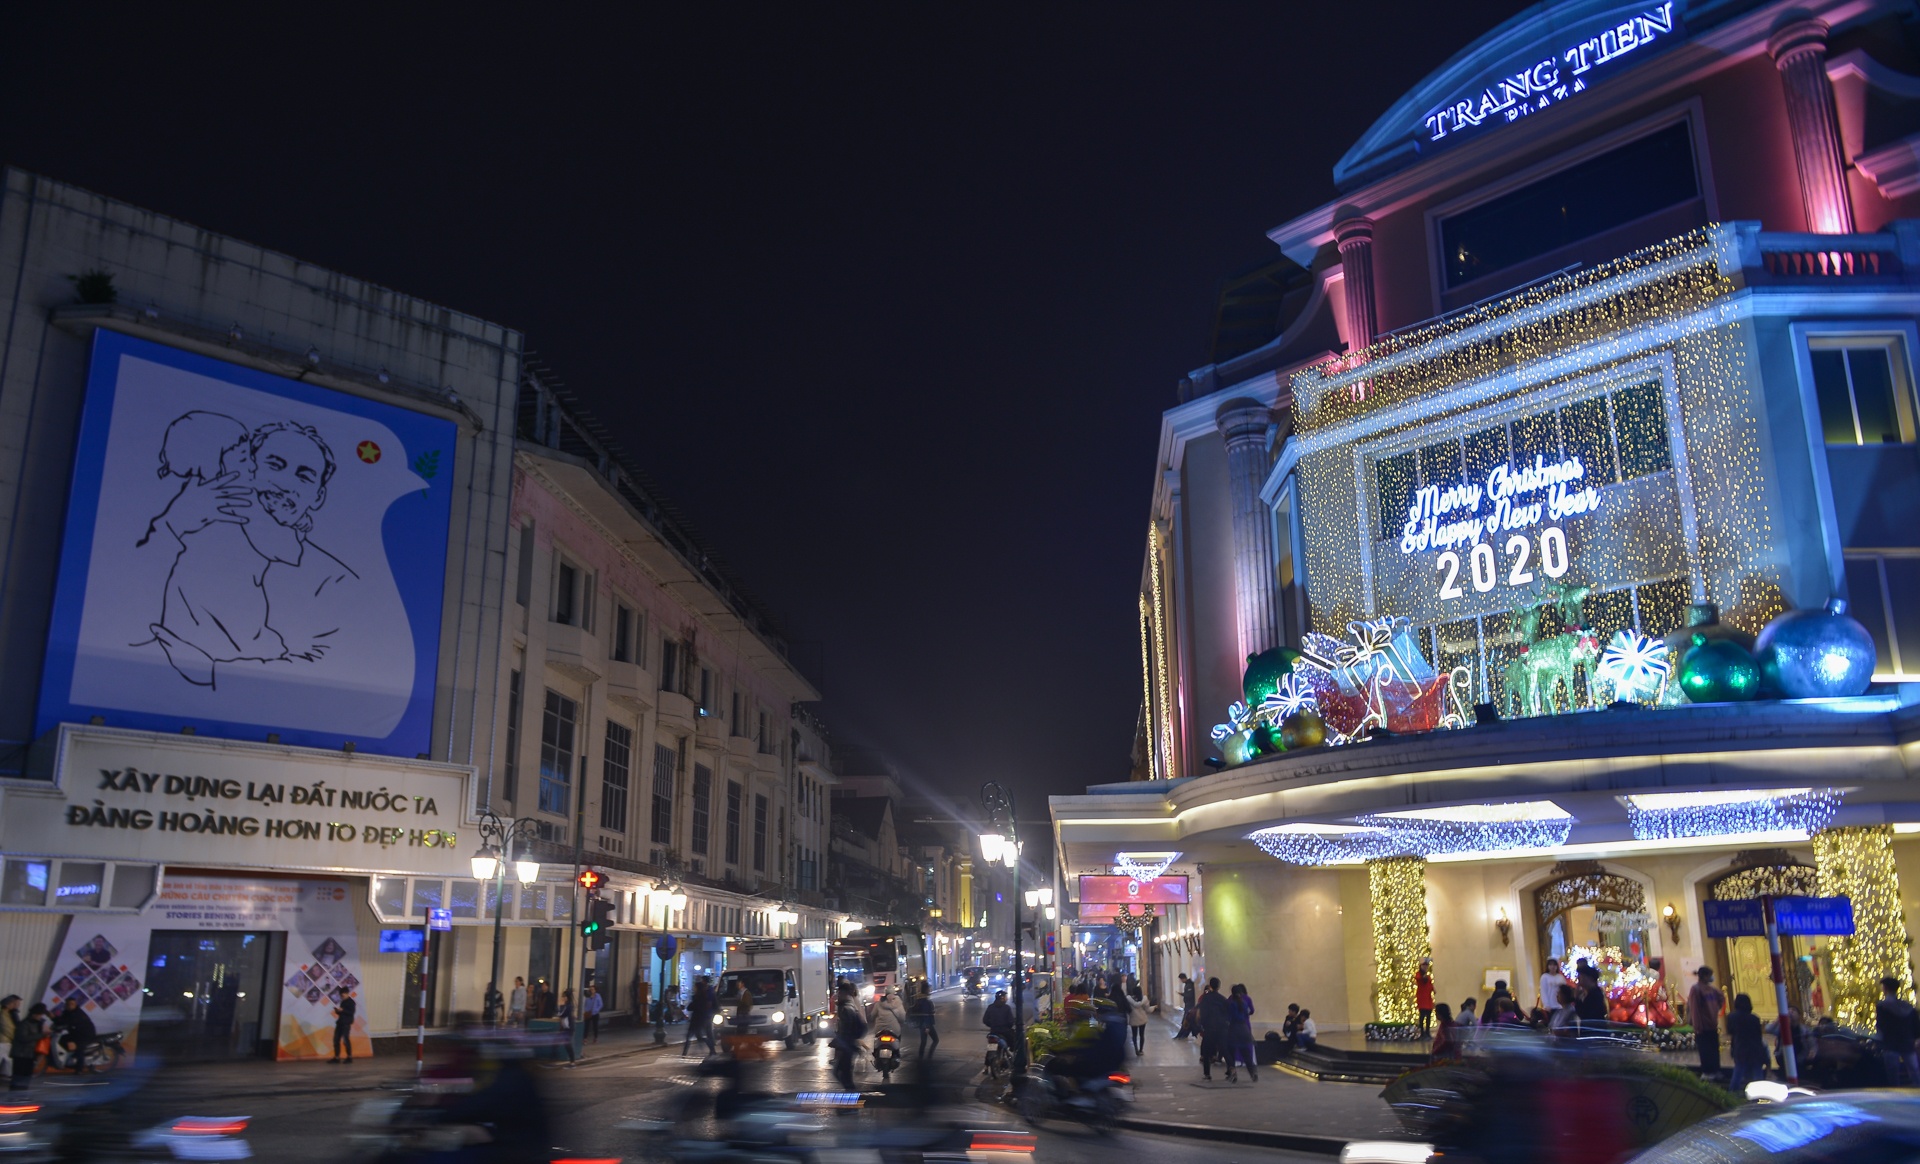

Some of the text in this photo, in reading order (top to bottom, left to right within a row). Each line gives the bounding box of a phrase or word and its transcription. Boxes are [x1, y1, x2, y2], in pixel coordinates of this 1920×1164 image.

[1425, 1, 1673, 141] TRANG TIEN
[1505, 78, 1587, 123] PLAZA
[1410, 454, 1584, 523] Merry Christmas
[1487, 497, 1542, 533] New
[1549, 482, 1601, 520] Year
[1437, 527, 1568, 600] 2020
[98, 767, 438, 816] XÂY DỰNG LẠI ĐẤT NƯỚC TA
[65, 799, 457, 849] ĐÀNG HOÀNG HƠN TO ĐẸP HƠN
[160, 891, 188, 900] HỮNG
[204, 912, 236, 920] BEHIND
